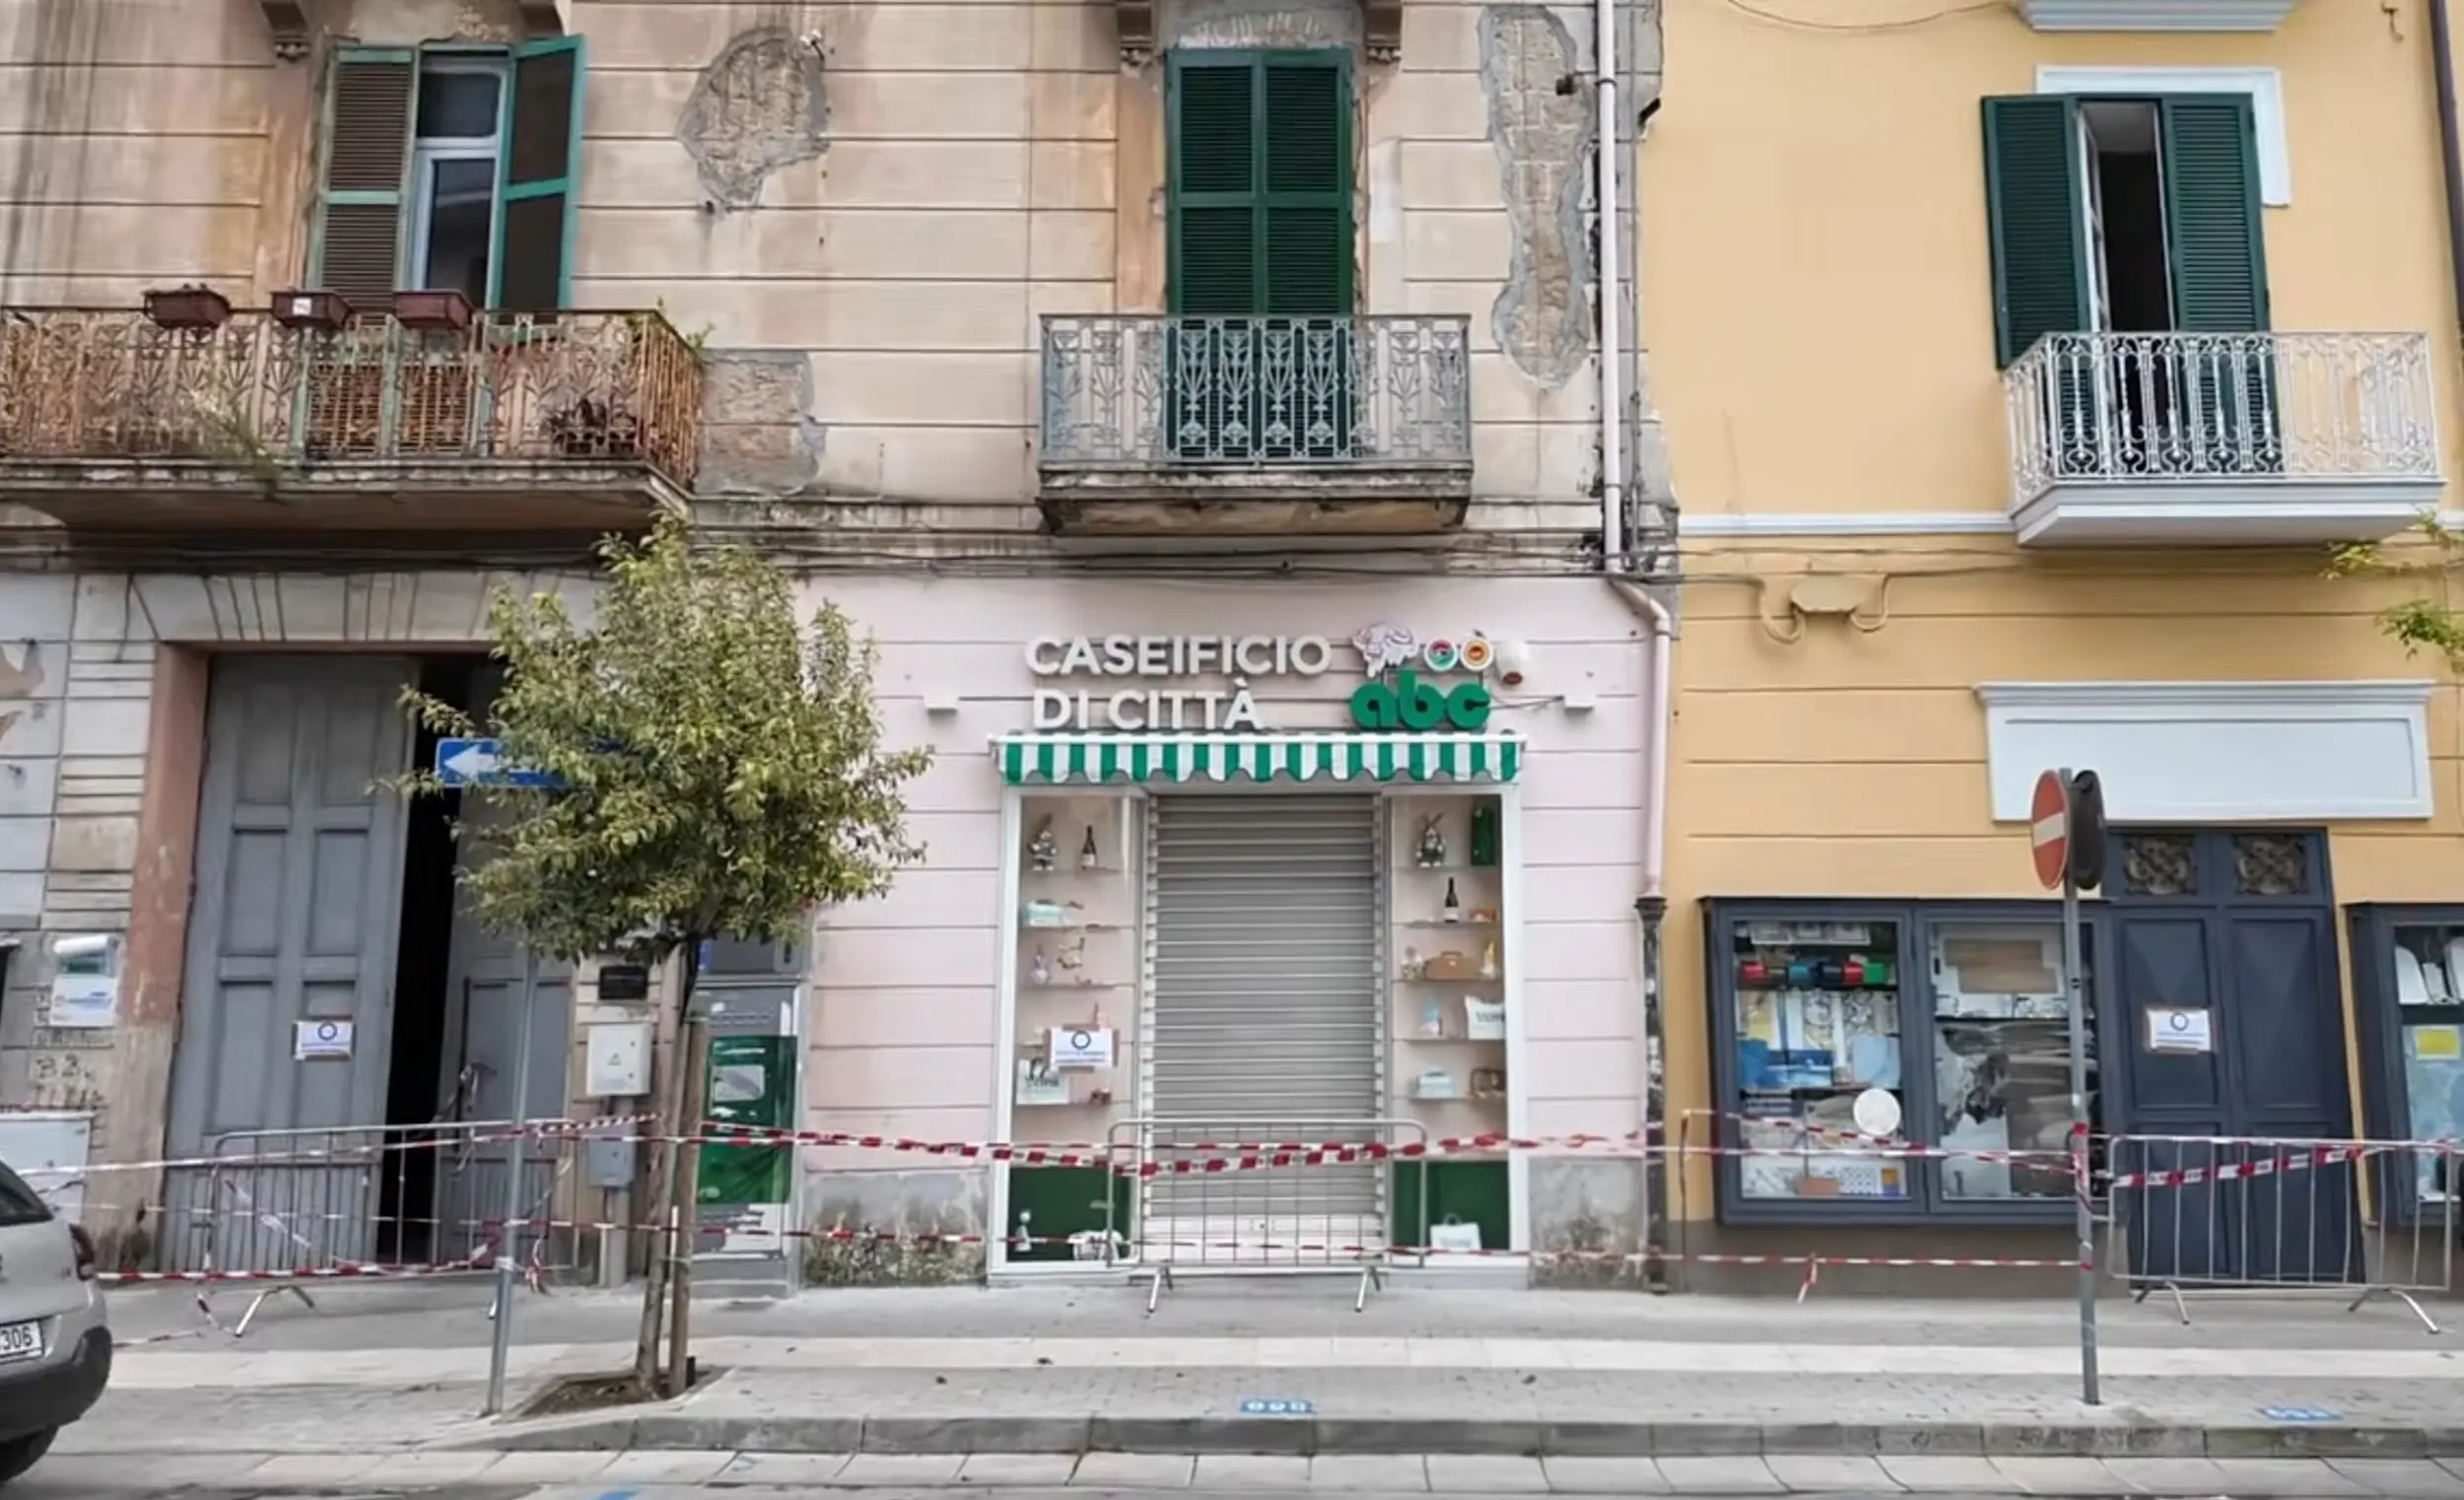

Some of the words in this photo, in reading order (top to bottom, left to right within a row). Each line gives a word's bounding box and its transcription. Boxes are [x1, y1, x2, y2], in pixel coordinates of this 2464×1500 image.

[1025, 635, 1333, 676] CASEIFICIO
[1033, 689, 1089, 731] DI
[1107, 676, 1265, 731] CITTÀ
[1351, 669, 1491, 730] abc
